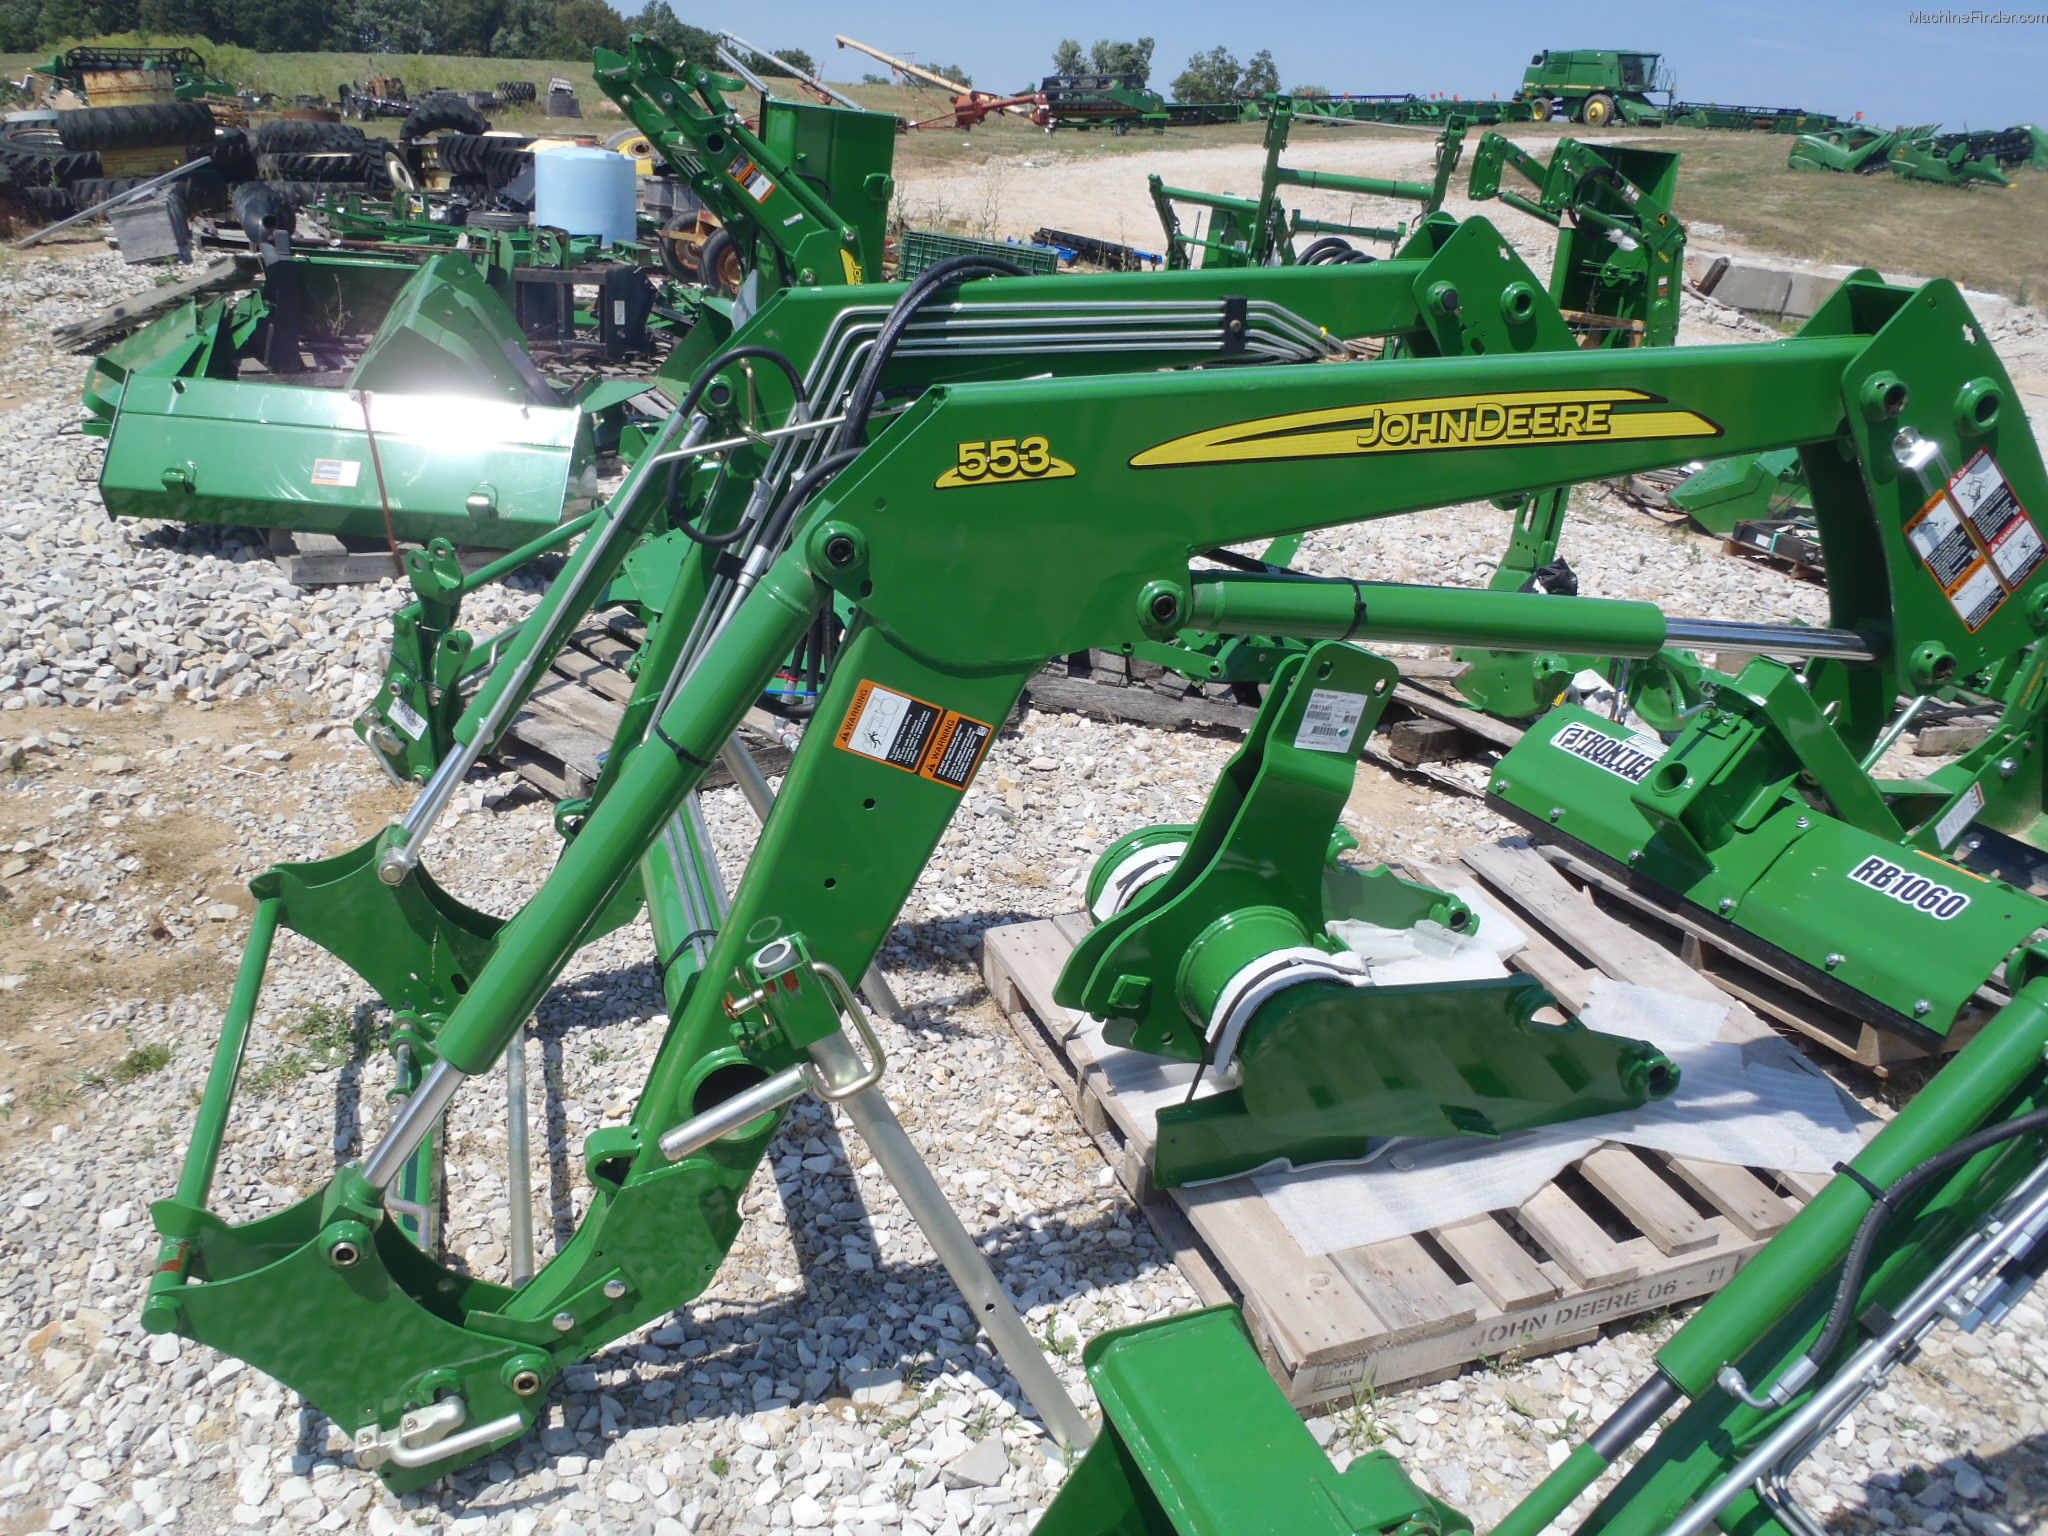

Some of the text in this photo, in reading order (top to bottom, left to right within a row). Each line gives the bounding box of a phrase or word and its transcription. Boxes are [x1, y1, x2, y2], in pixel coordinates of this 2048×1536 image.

[1357, 402, 1613, 447] JOHN DEERE
[957, 436, 1051, 480] 553
[844, 688, 868, 730] WARNING
[931, 719, 955, 760] WARNING
[1852, 857, 1968, 919] RB1060
[1471, 1313, 1547, 1348] JOHN
[1555, 1288, 1639, 1326] DEERE
[1647, 1279, 1677, 1300] 06
